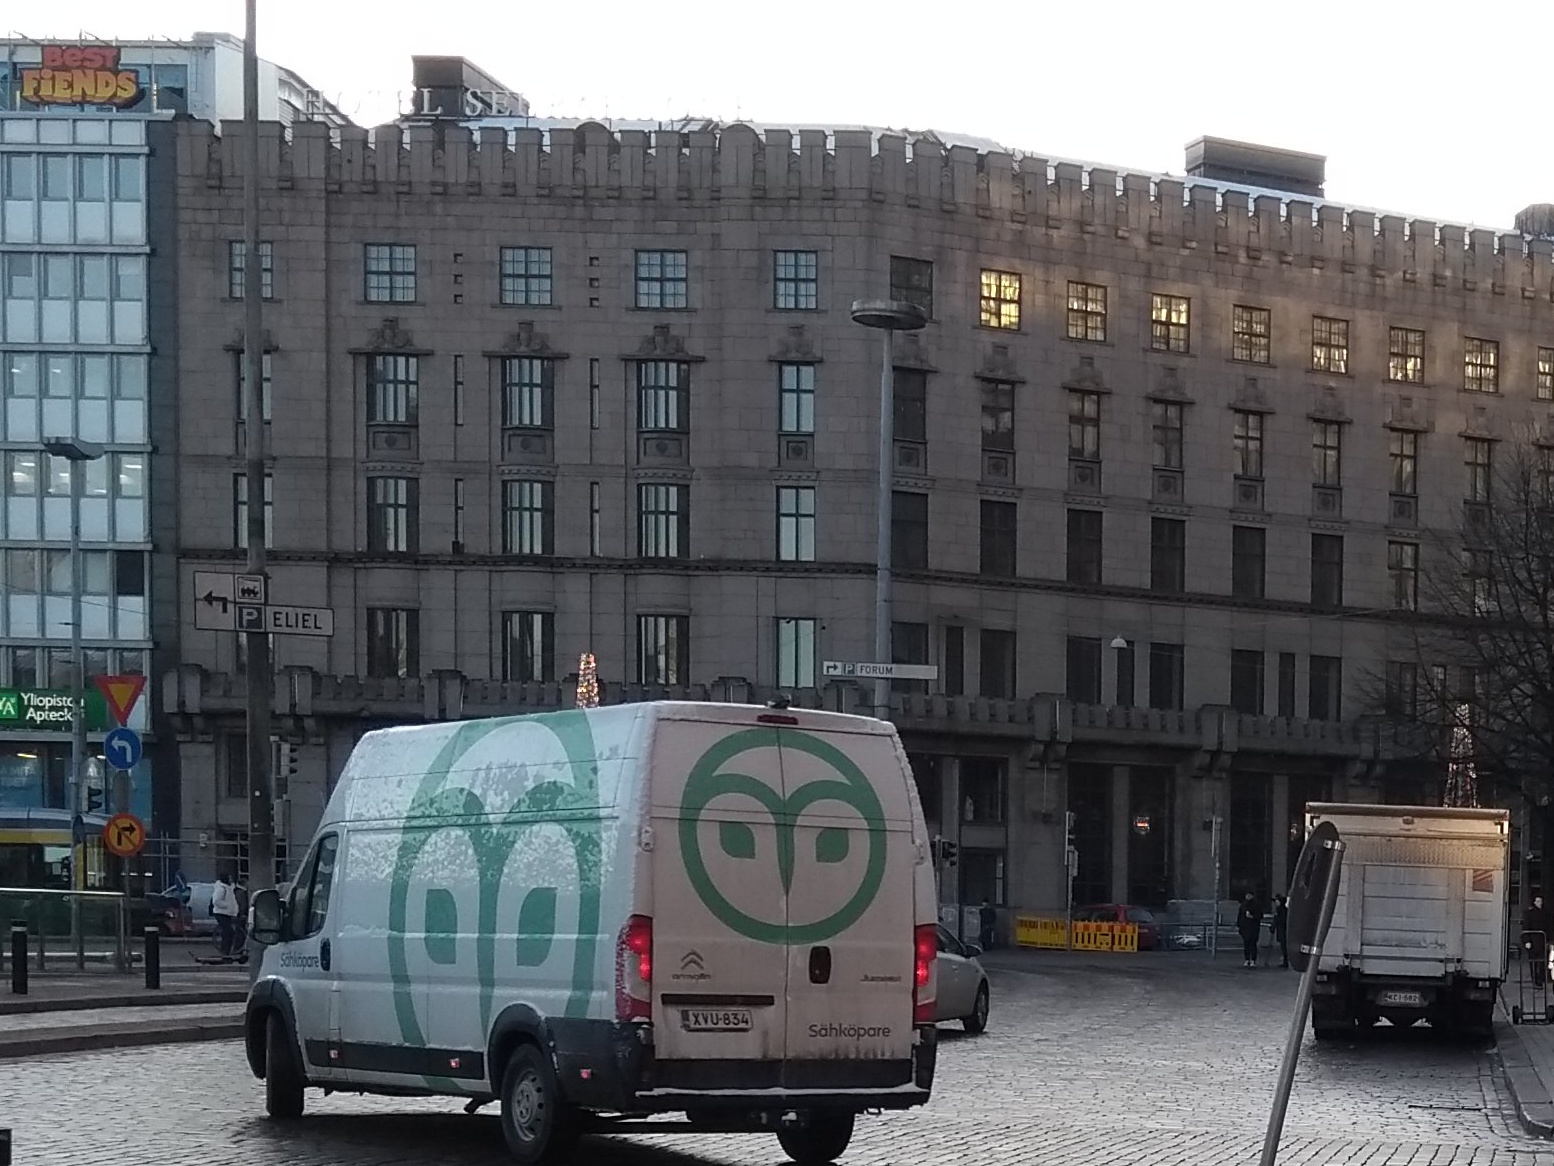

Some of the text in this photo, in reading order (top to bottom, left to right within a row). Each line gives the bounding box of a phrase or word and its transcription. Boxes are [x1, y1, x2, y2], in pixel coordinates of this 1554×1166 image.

[273, 611, 322, 630] ELIEL
[860, 665, 893, 675] FORUM
[20, 692, 84, 710] Yliopisto
[692, 1012, 750, 1027] XVU-834
[808, 1023, 891, 1041] Sähköpare
